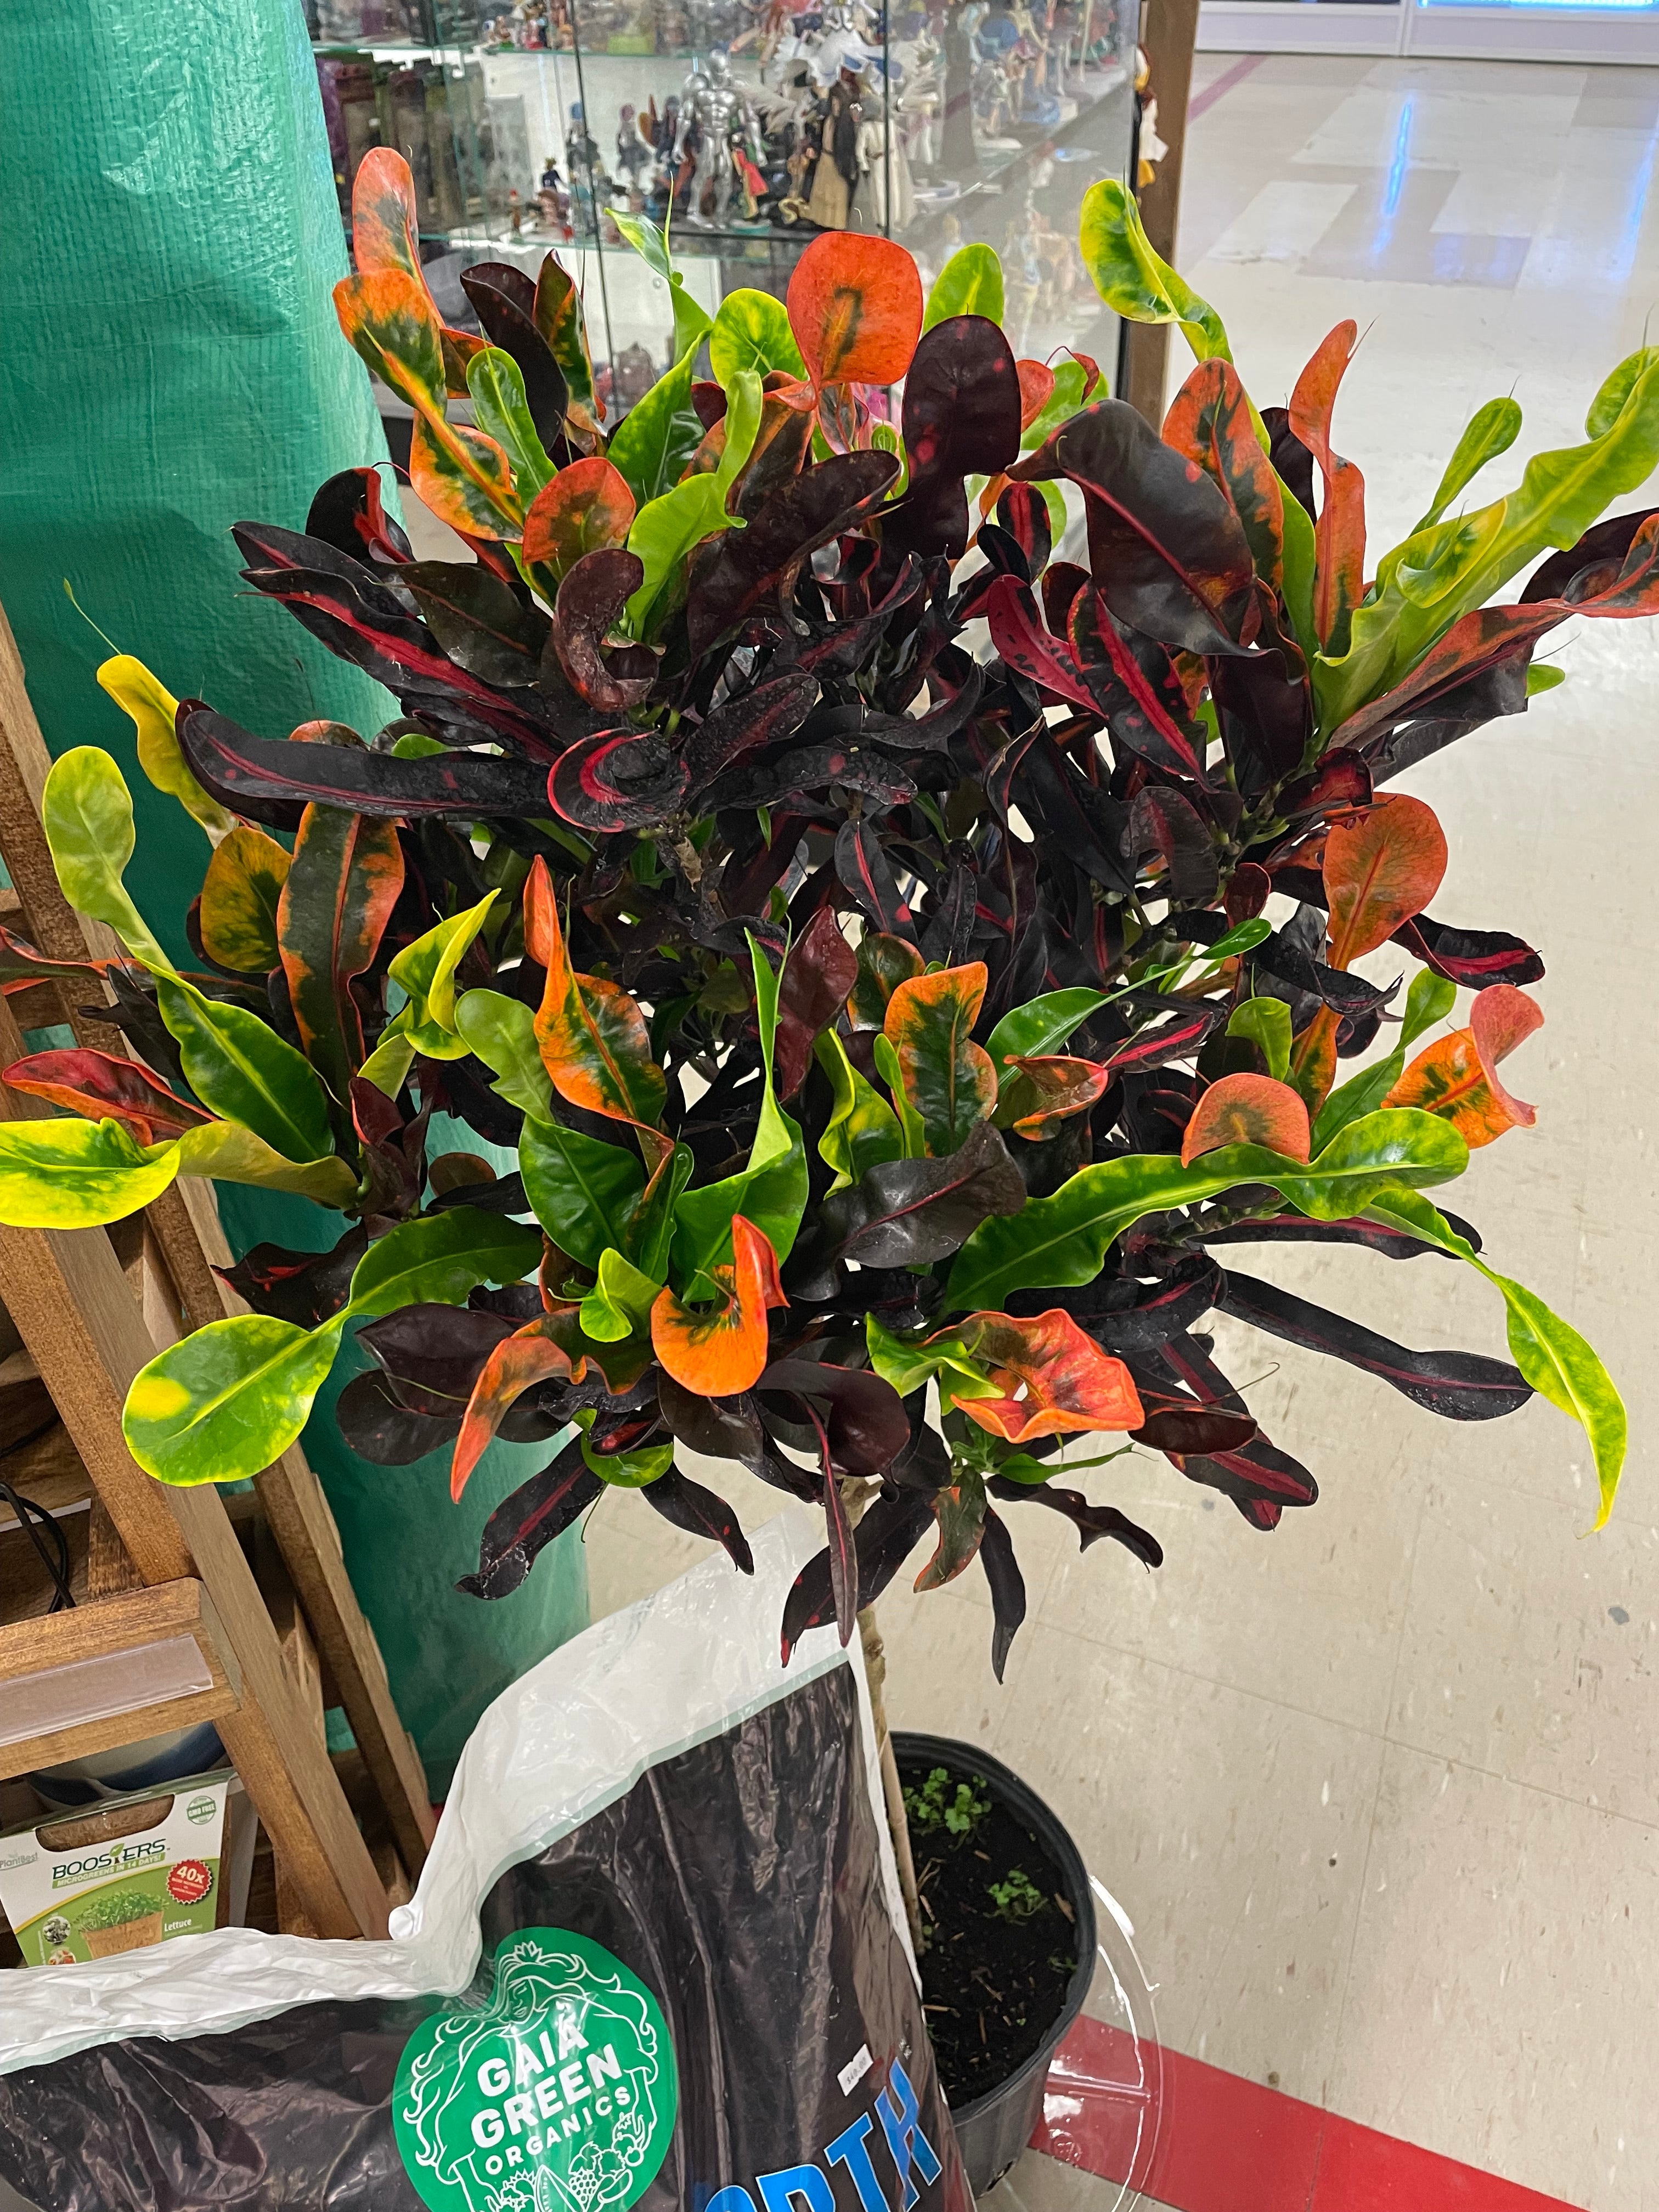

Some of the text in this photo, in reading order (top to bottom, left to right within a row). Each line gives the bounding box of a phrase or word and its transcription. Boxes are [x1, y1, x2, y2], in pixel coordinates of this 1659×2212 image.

[57, 1867, 115, 1887] MICROGREENS
[116, 1863, 125, 1872] IN
[139, 1854, 161, 1865] DAYS!
[177, 1866, 205, 1884] 40x
[165, 1919, 192, 1932] Lettuce
[471, 2044, 623, 2148] GREEN
[477, 2023, 589, 2097] GAIA
[486, 2086, 630, 2175] ORGANICS
[704, 2056, 943, 2212] TH
